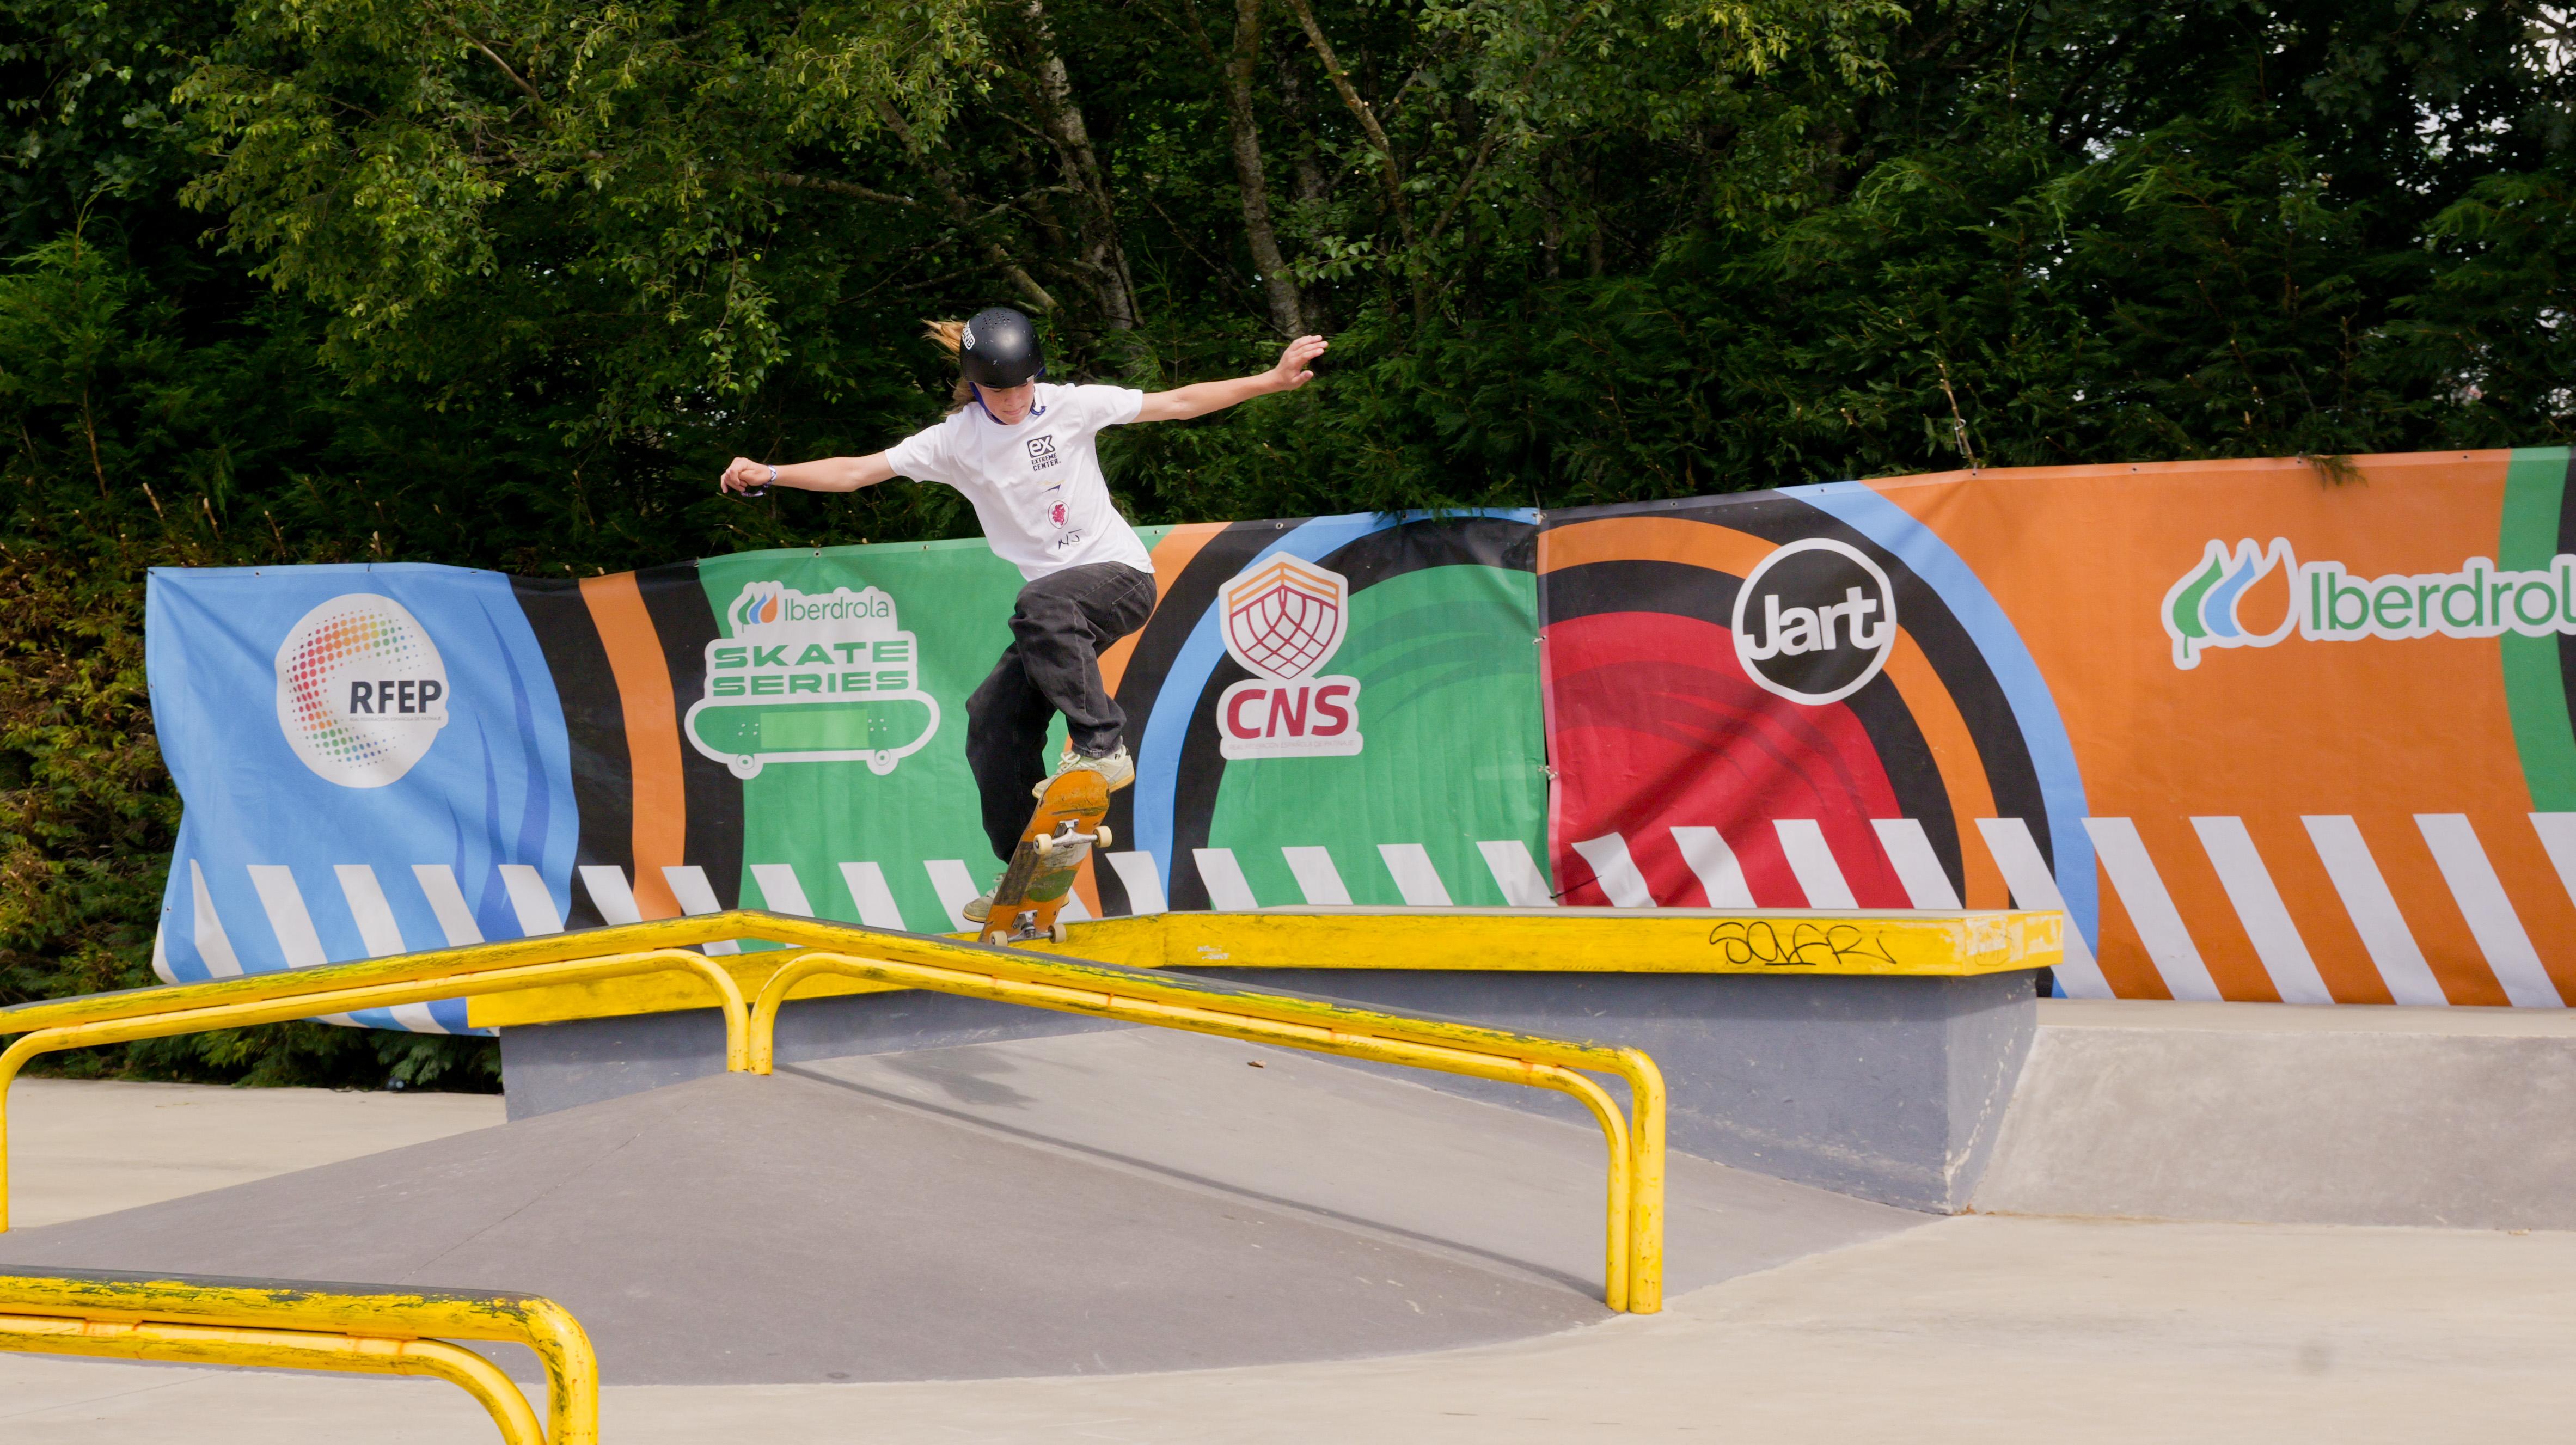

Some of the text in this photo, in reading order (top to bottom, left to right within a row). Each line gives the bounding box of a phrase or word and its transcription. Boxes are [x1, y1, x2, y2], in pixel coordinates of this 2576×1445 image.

[1031, 452, 1057, 465] EXTREME
[785, 596, 889, 621] Iberdrola
[1743, 586, 1886, 660] Jart
[714, 640, 909, 669] SKATE
[350, 679, 442, 714] RFEP
[712, 670, 909, 697] SERIES
[1226, 684, 1351, 739] CNS
